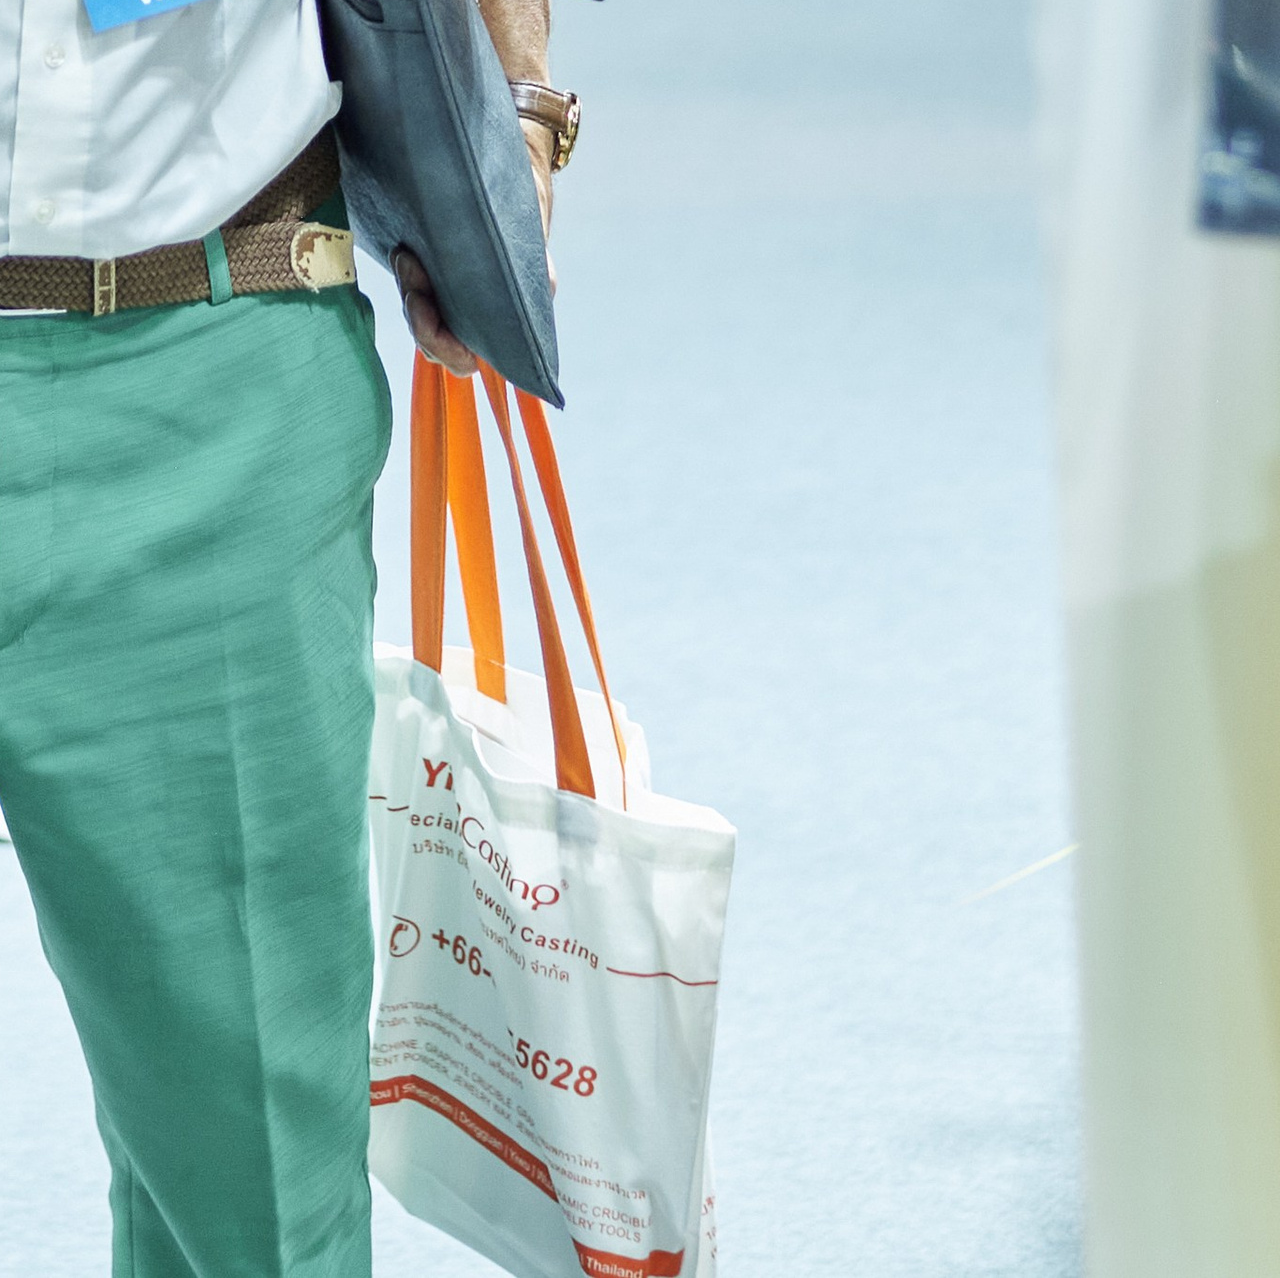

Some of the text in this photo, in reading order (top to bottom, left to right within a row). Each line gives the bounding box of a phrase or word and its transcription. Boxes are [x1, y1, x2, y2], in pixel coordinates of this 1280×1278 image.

[520, 926, 599, 969] Casting
[530, 959, 570, 982] จำกัด
[598, 1222, 641, 1244] TOOLS
[585, 1254, 644, 1278] Thailand
